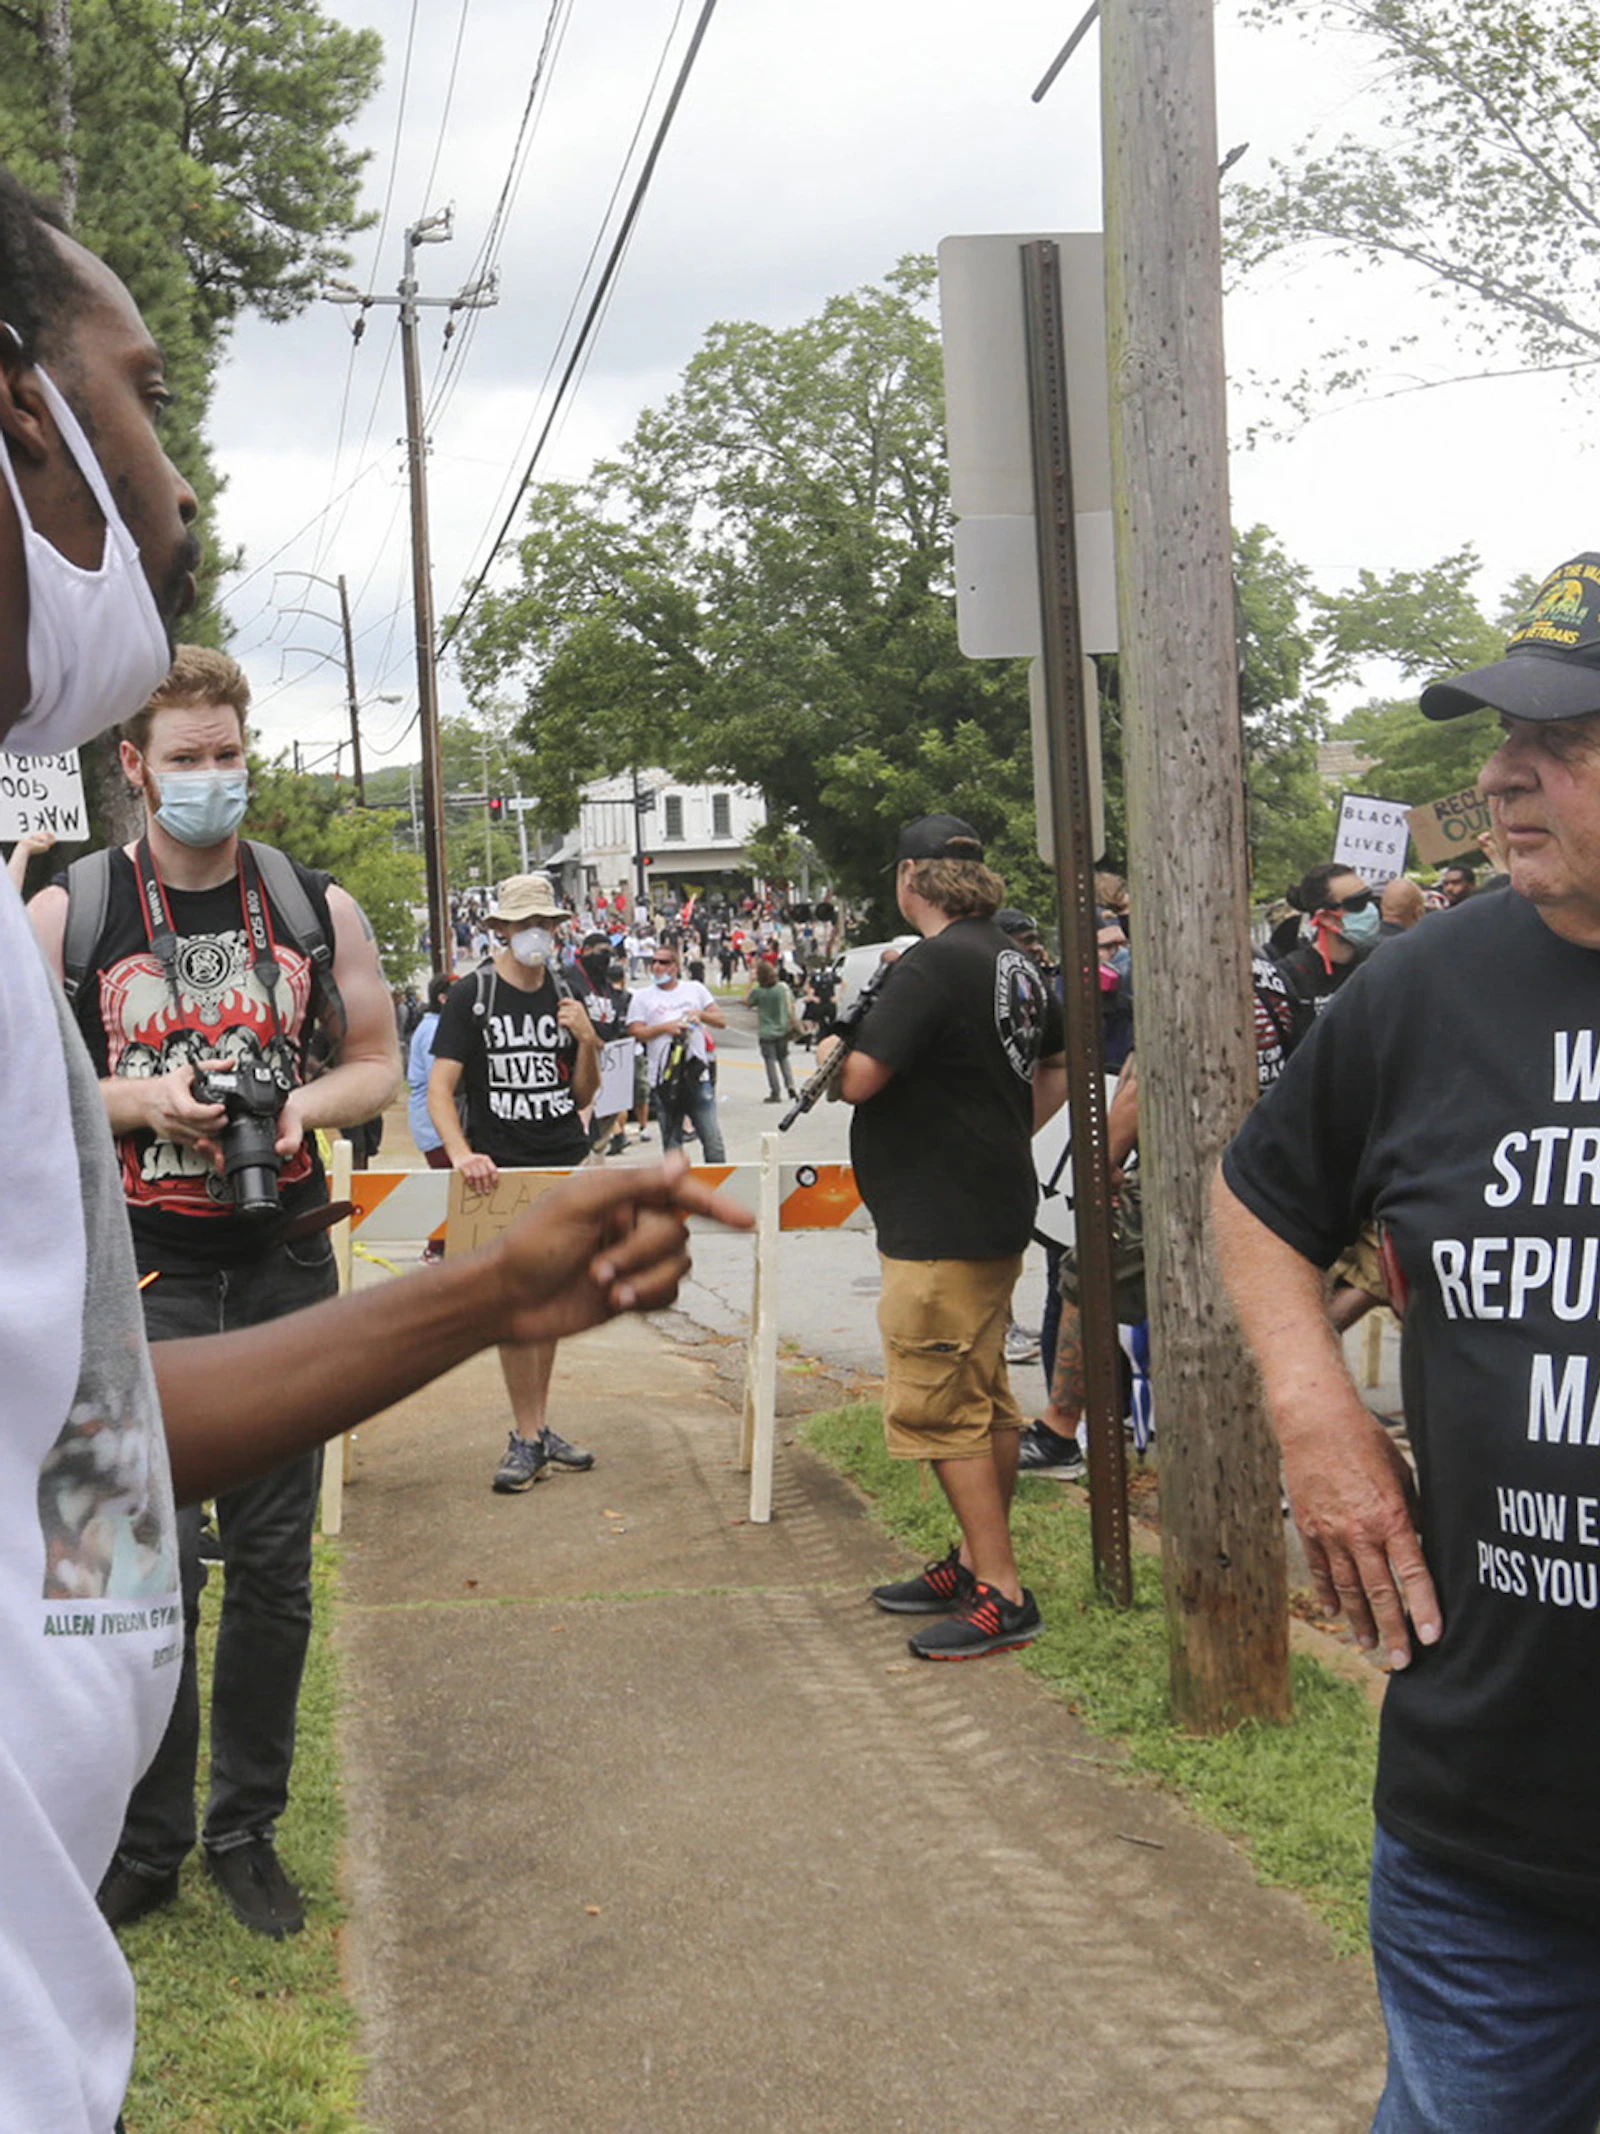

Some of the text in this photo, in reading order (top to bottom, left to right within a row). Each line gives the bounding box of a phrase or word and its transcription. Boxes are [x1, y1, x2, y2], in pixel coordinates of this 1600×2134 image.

[18, 805, 79, 833] MAKE
[1433, 789, 1488, 821] RECL
[1443, 807, 1492, 842] OU
[1343, 836, 1397, 855] LIVES
[146, 879, 164, 926] Canon
[250, 916, 267, 949] EOS
[490, 1055, 556, 1084] LIVES
[600, 1043, 630, 1073] UST
[460, 1180, 545, 1216] BLA
[1431, 1236, 1599, 1321] REPU
[1496, 1486, 1567, 1543] HOW
[1477, 1539, 1598, 1611] PISS YOU
[43, 1614, 96, 1637] ALLEN
